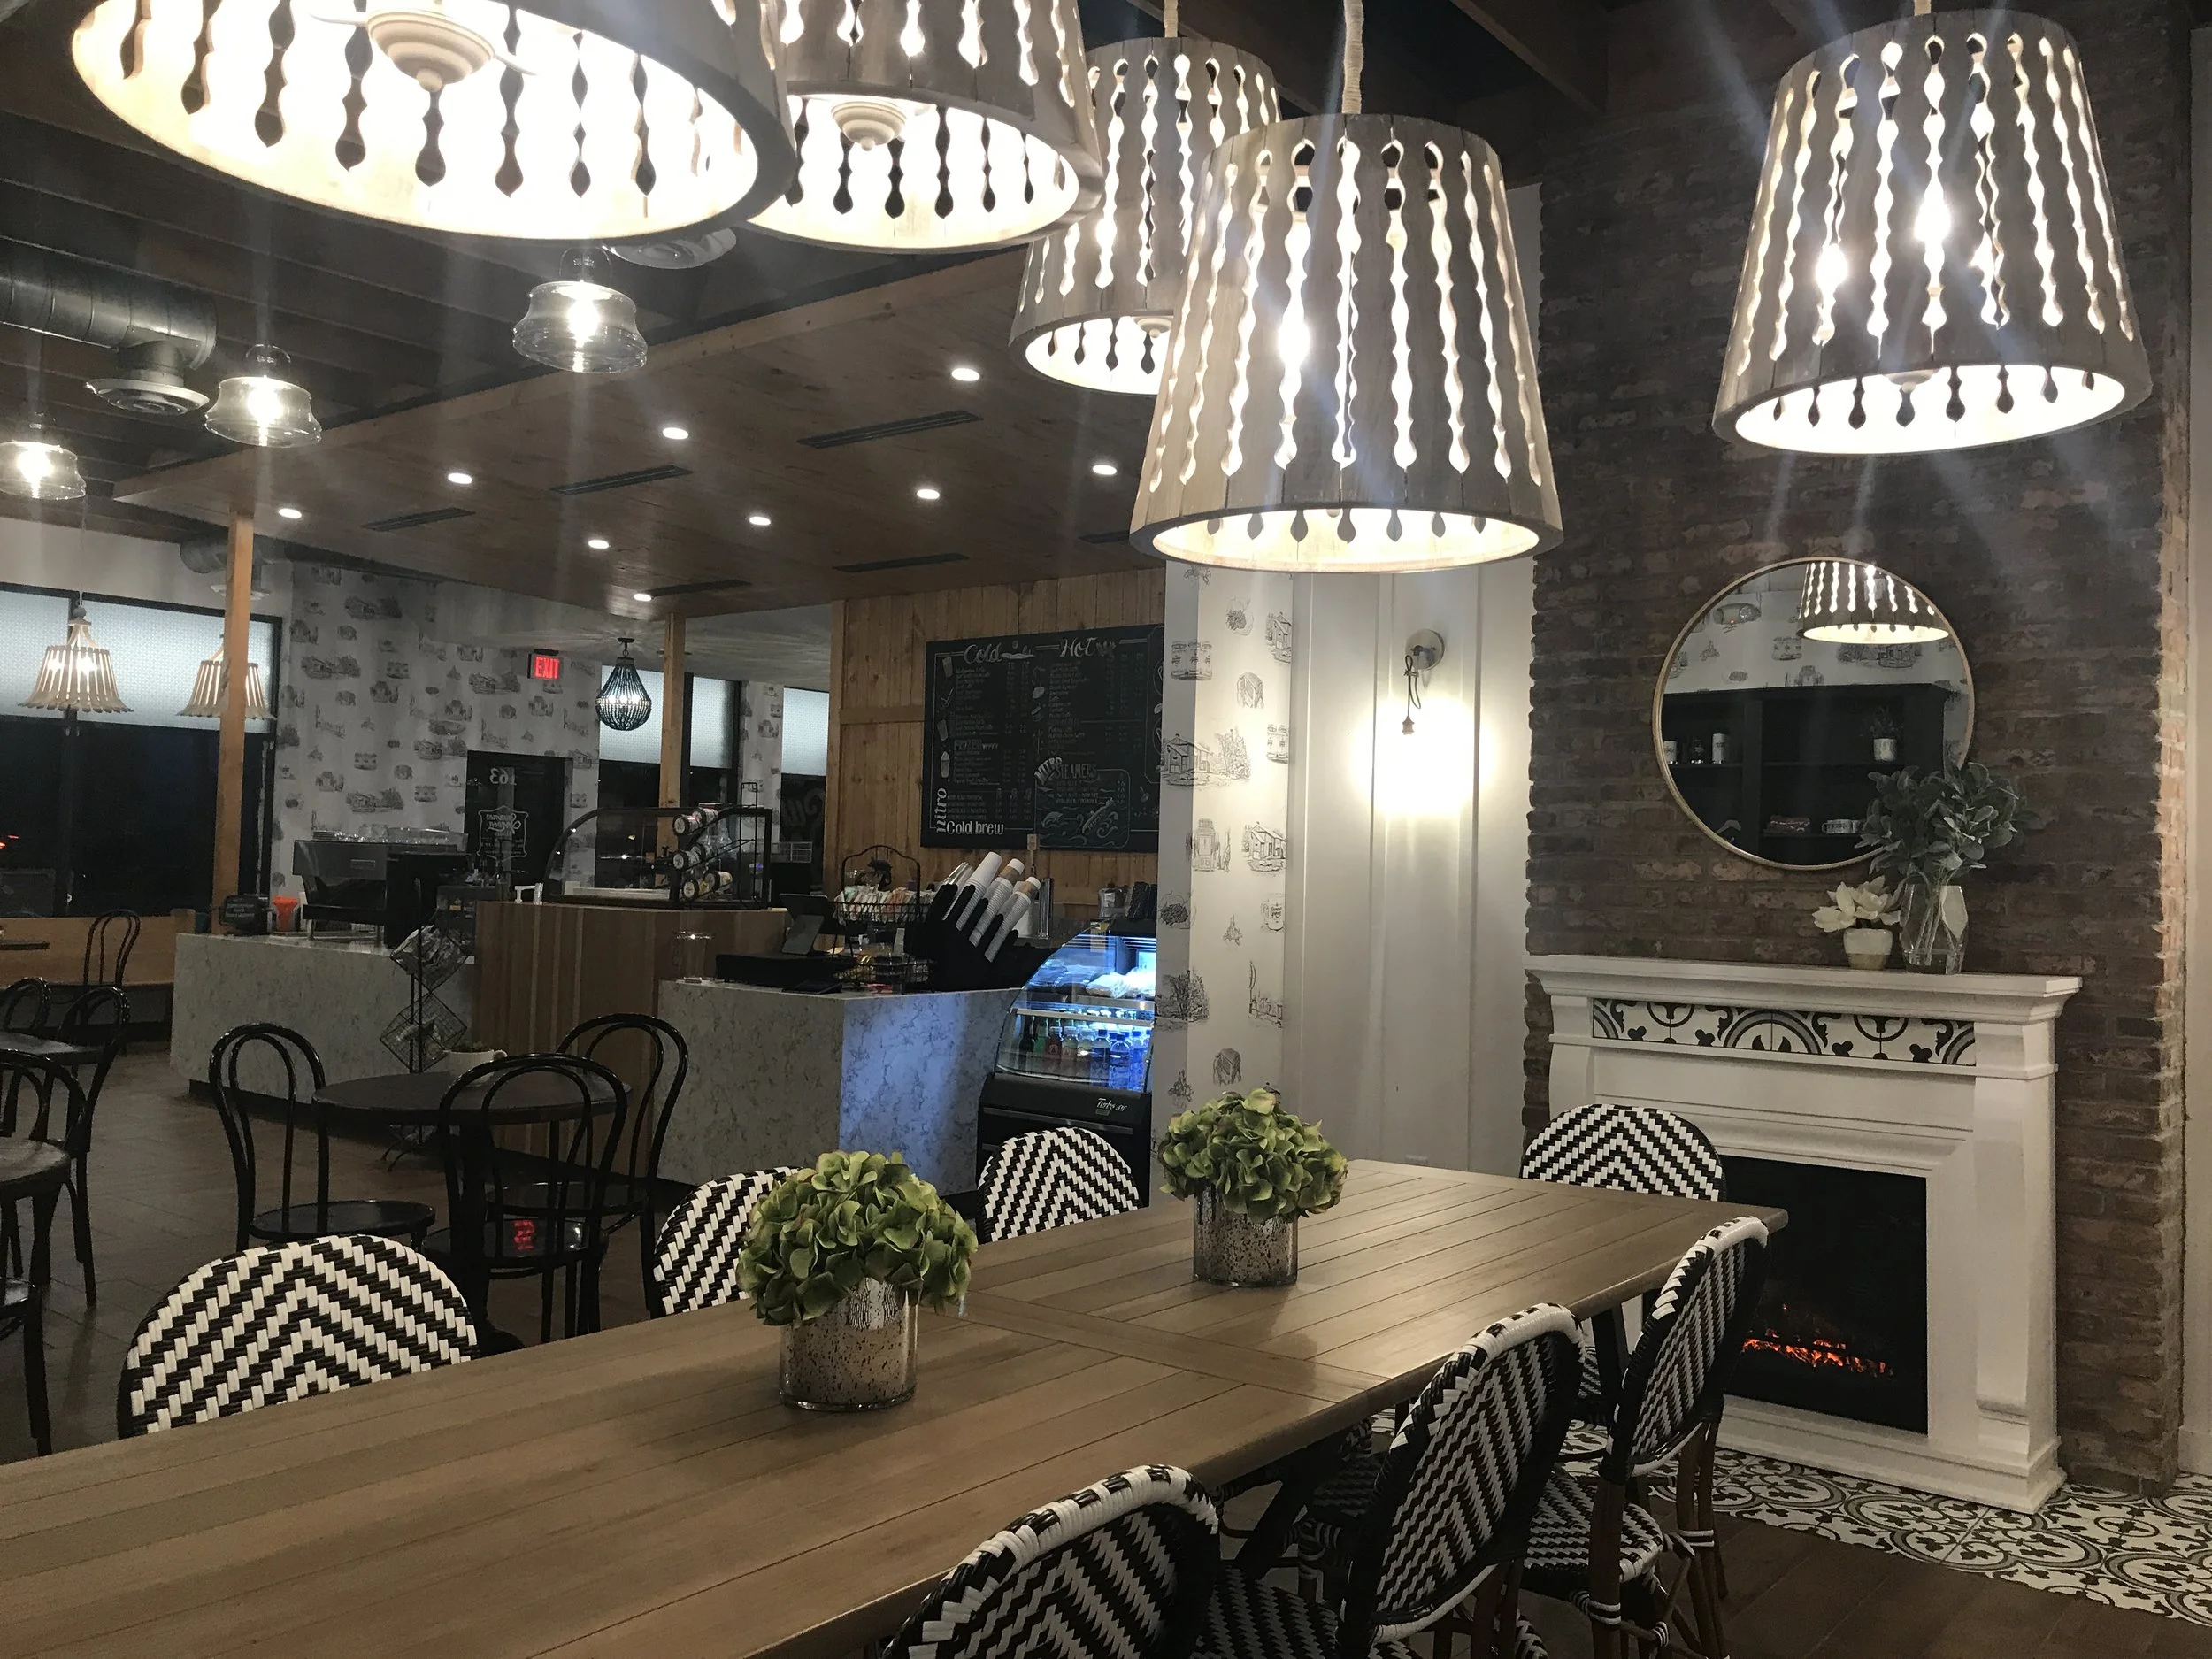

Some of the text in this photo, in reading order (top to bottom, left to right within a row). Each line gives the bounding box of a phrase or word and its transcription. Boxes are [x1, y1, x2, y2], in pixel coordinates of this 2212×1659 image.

[963, 641, 1002, 664] Cold
[1059, 636, 1097, 657] Hot
[534, 656, 560, 680] EXIT
[1055, 764, 1097, 780] STEAMERS
[935, 787, 949, 833] nitro
[946, 820, 1004, 835] Cold brew
